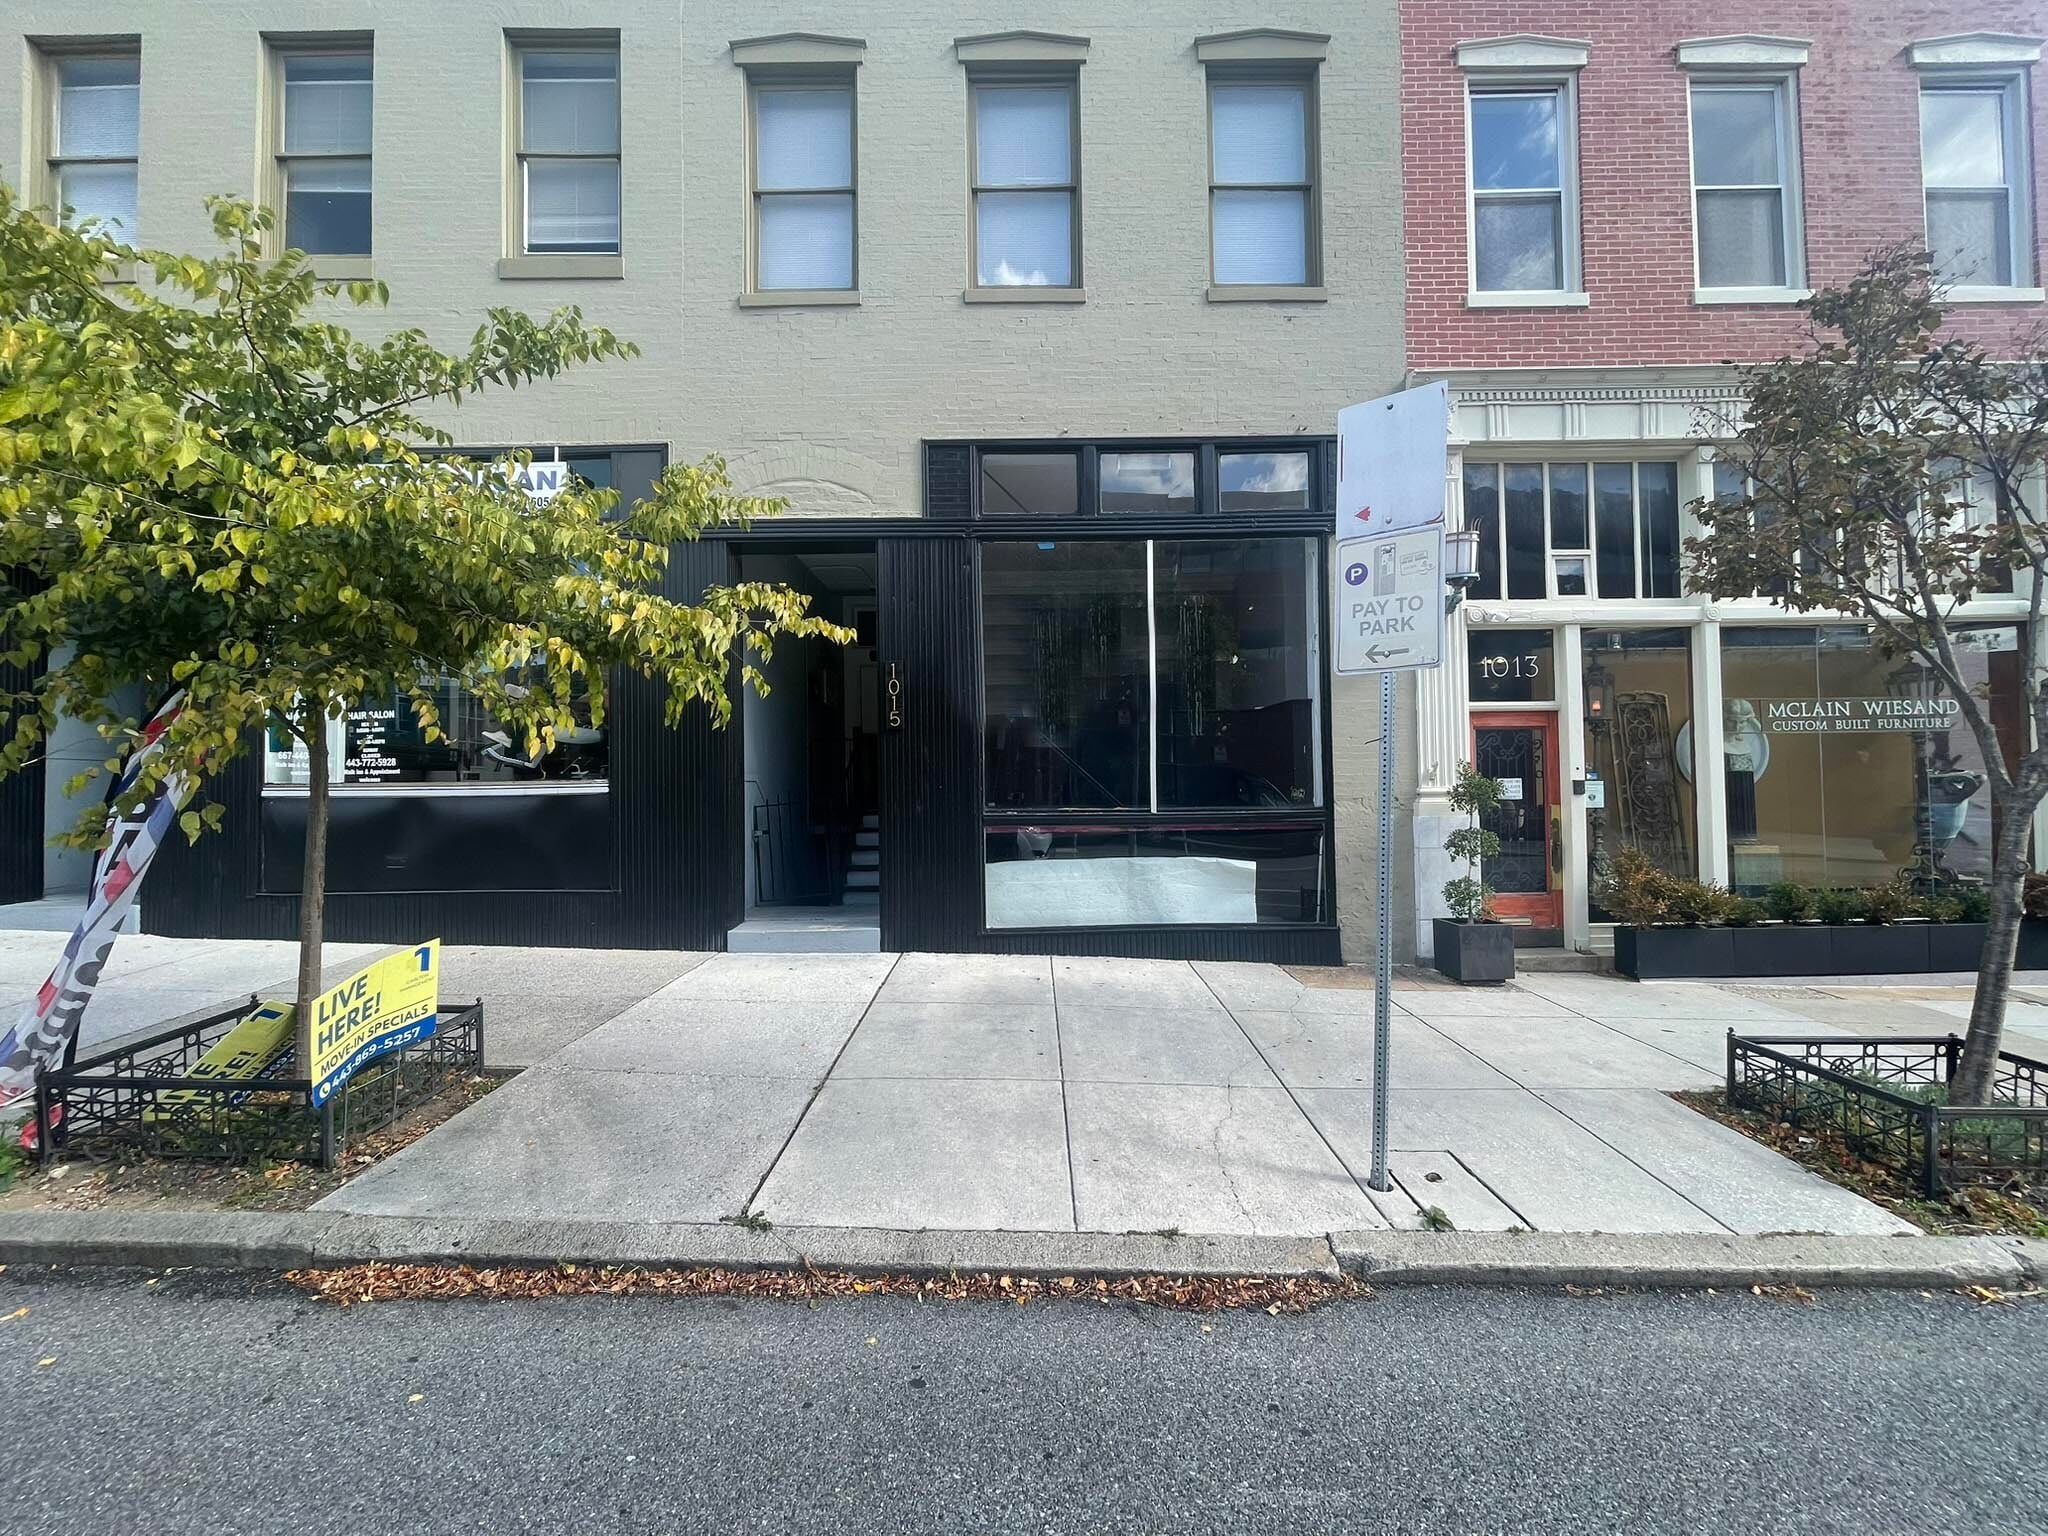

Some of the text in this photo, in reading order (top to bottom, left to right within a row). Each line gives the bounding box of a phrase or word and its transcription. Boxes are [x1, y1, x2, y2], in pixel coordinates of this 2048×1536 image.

[1352, 595, 1424, 619] PAY TO
[1359, 615, 1415, 637] PARK
[1481, 655, 1539, 678] 1013
[888, 663, 901, 727] 1015
[347, 709, 395, 720] HAIR SALON
[1768, 699, 1960, 718] MCLAIN WIESAND
[1772, 717, 1952, 731] CUSTOM BUILT FURNITURE
[345, 757, 397, 767] 443-772-5928
[318, 973, 368, 1026] LIVE
[318, 991, 382, 1055] HERE!
[320, 1033, 365, 1077] MOVE-IN
[367, 1004, 429, 1039] SPECIALS
[331, 1026, 421, 1088] 443-869-5257
